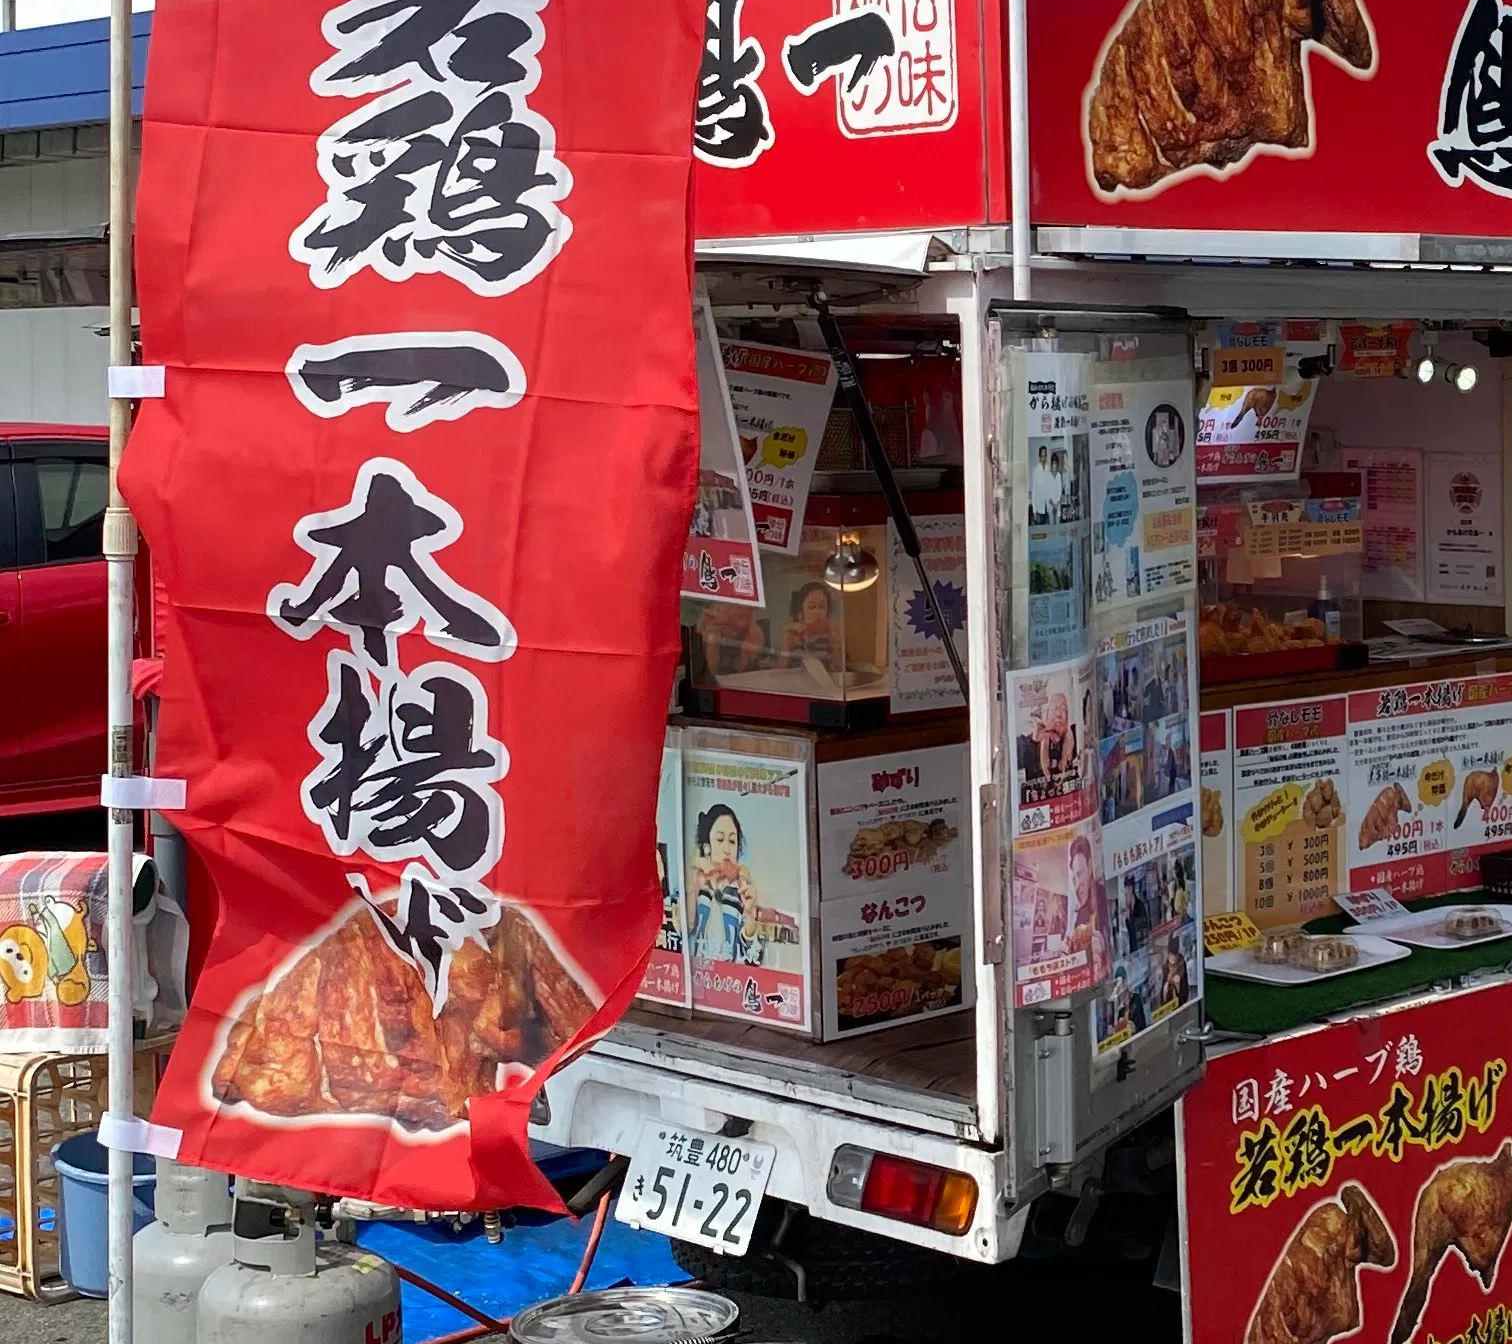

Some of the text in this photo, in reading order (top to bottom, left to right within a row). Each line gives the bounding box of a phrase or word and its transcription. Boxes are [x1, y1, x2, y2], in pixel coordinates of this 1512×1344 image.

[1241, 358, 1273, 372] 300円
[1376, 682, 1466, 717] 若鶏一本揚げ
[1267, 705, 1322, 728] 骨なしモモ
[1484, 822, 1512, 838] 495円
[1259, 843, 1275, 856] 3個
[1303, 834, 1329, 849] 300円
[1387, 840, 1418, 857] 495円
[851, 850, 910, 880] 300円
[1259, 860, 1275, 874] 5個
[1303, 851, 1329, 866] 500円
[1258, 877, 1274, 890] 8個
[1302, 867, 1329, 883] 800円
[1254, 895, 1275, 909] 10個
[1299, 885, 1329, 902] 1000円
[861, 895, 927, 924] なんこつ
[1231, 1034, 1425, 1124] 国産ハーブ鶏
[1230, 1058, 1507, 1215] 若鶏一本揚げ
[665, 1132, 742, 1175] 筑豊 480
[632, 1165, 752, 1245] き 51-22
